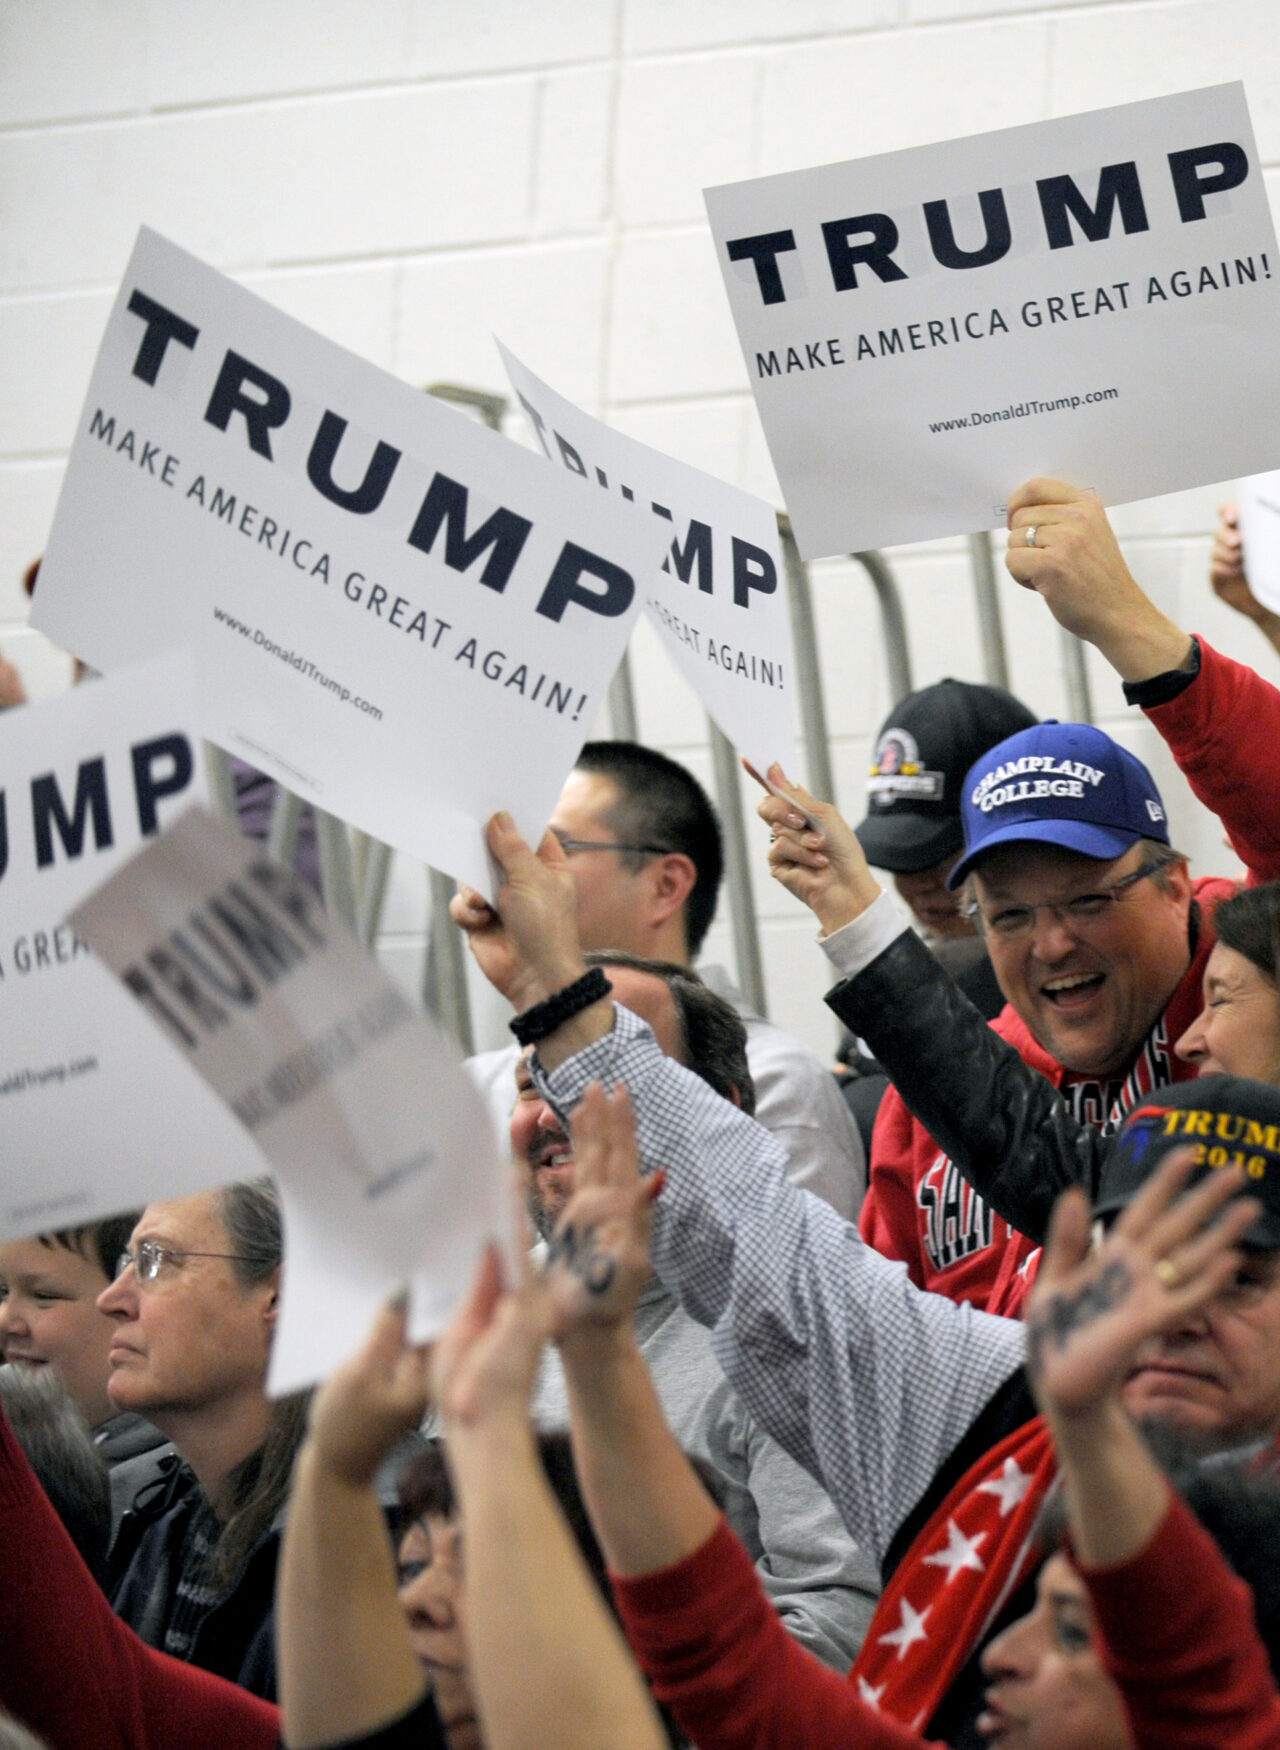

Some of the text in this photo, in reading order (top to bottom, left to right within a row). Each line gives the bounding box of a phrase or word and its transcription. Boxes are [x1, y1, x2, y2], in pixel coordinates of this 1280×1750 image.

[726, 141, 1250, 305] TRUMP
[755, 253, 1273, 378] MAKE AMERICA GREAT AGAIN!
[126, 288, 636, 624] TRUMP
[928, 388, 1119, 434] www.DonaldJTrump.com
[88, 408, 589, 722] MAKE AMERICA GREAT AGAIN!
[213, 606, 384, 722] www.DonaldJTrump.com
[707, 638, 784, 690] AGAIN!
[971, 756, 1106, 806] CHAMPLAIN
[980, 780, 1085, 813] COLLEGE
